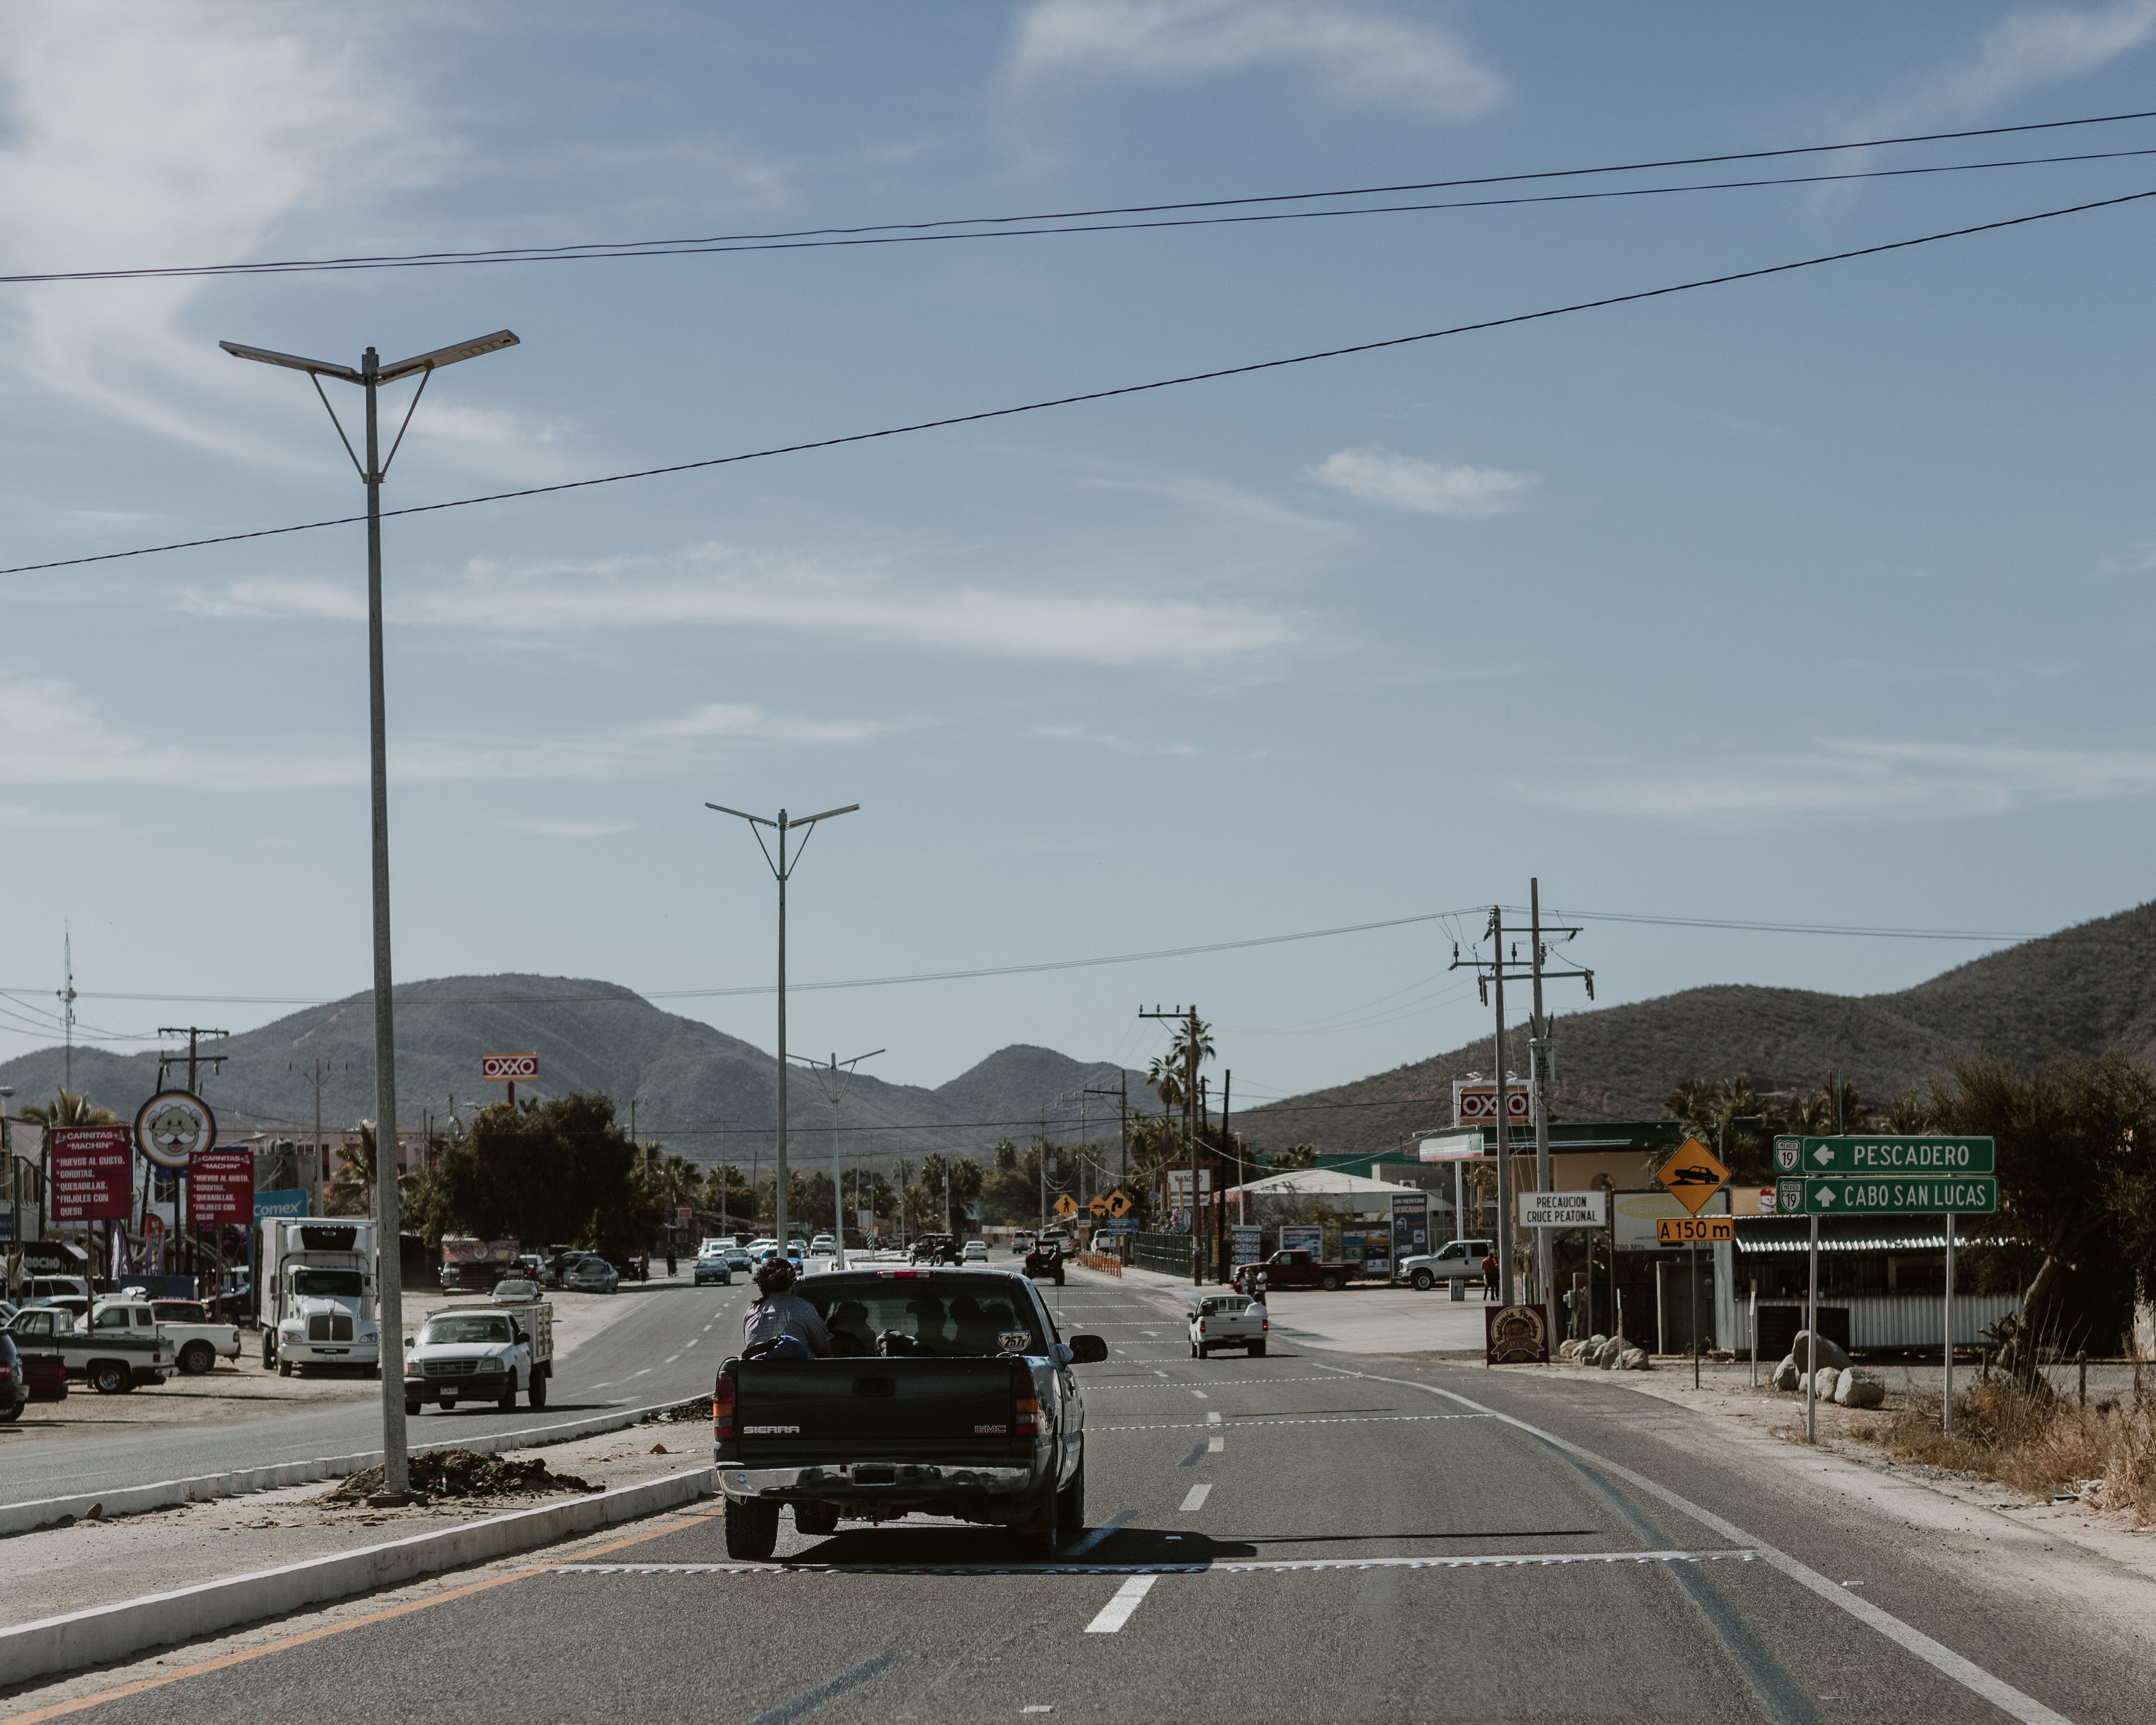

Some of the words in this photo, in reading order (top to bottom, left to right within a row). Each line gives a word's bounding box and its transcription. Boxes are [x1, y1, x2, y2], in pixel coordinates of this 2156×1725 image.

[485, 1059, 535, 1075] OXXO
[67, 1131, 113, 1140] CARNITAS
[89, 1157, 97, 1166] AL
[99, 1156, 125, 1165] GUSTO.
[1782, 1152, 1793, 1166] 19
[1854, 1146, 1970, 1166] PESCADERO
[93, 1194, 109, 1202] CON
[1537, 1196, 1587, 1208] PRECAUCION
[1787, 1193, 1797, 1207] 19
[1844, 1185, 1889, 1207] CABO
[1894, 1185, 1928, 1206] SAN
[1934, 1185, 1986, 1206] LUCAS
[60, 1207, 83, 1217] QUESO
[254, 1200, 303, 1216] Comex
[1527, 1211, 1552, 1222] CRUCE
[1555, 1210, 1597, 1222] PEATONAL
[1660, 1222, 1670, 1239] A
[1676, 1221, 1707, 1239] 150
[1712, 1225, 1730, 1238] m
